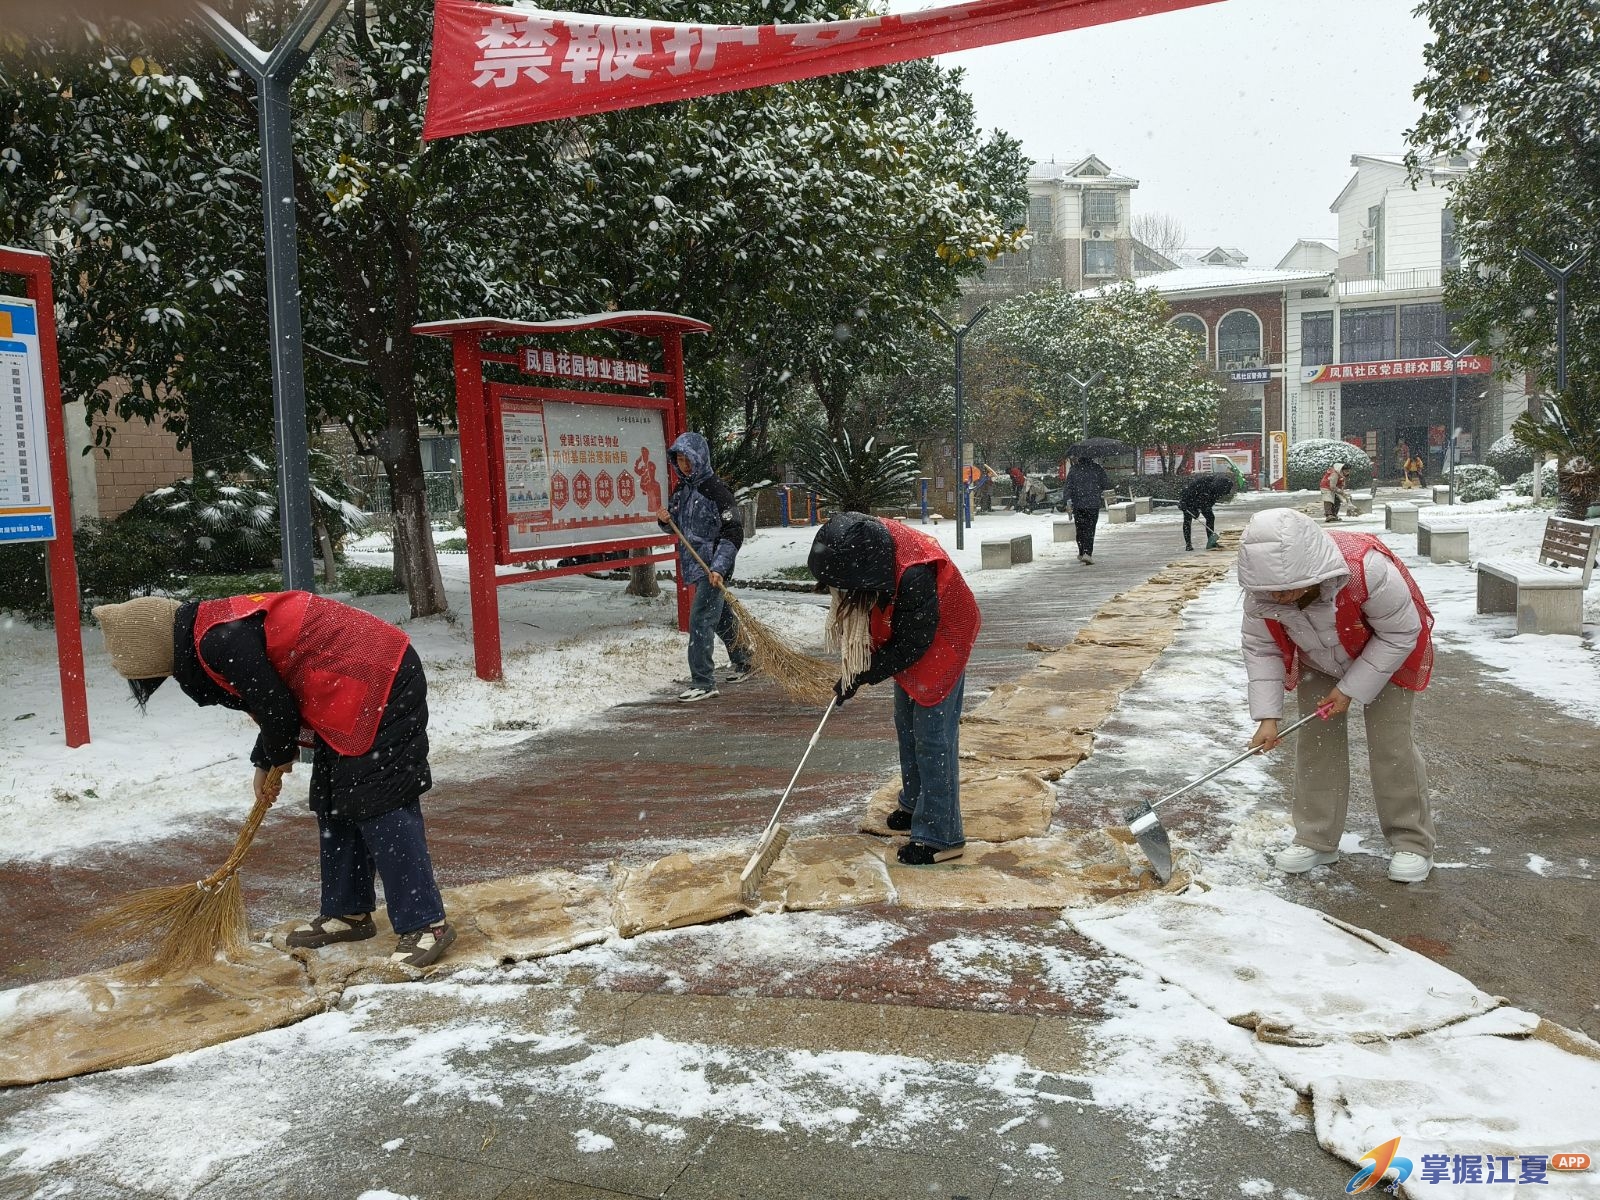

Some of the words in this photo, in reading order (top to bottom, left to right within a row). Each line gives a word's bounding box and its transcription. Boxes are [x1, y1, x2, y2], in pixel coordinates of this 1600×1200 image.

[526, 348, 650, 385] 凤凰花园物业通知栏
[1329, 358, 1482, 379] 凤凰社区党员群众服务中心
[559, 433, 620, 448] 党建引领红色物业
[552, 448, 629, 465] 开创基层治理新格局
